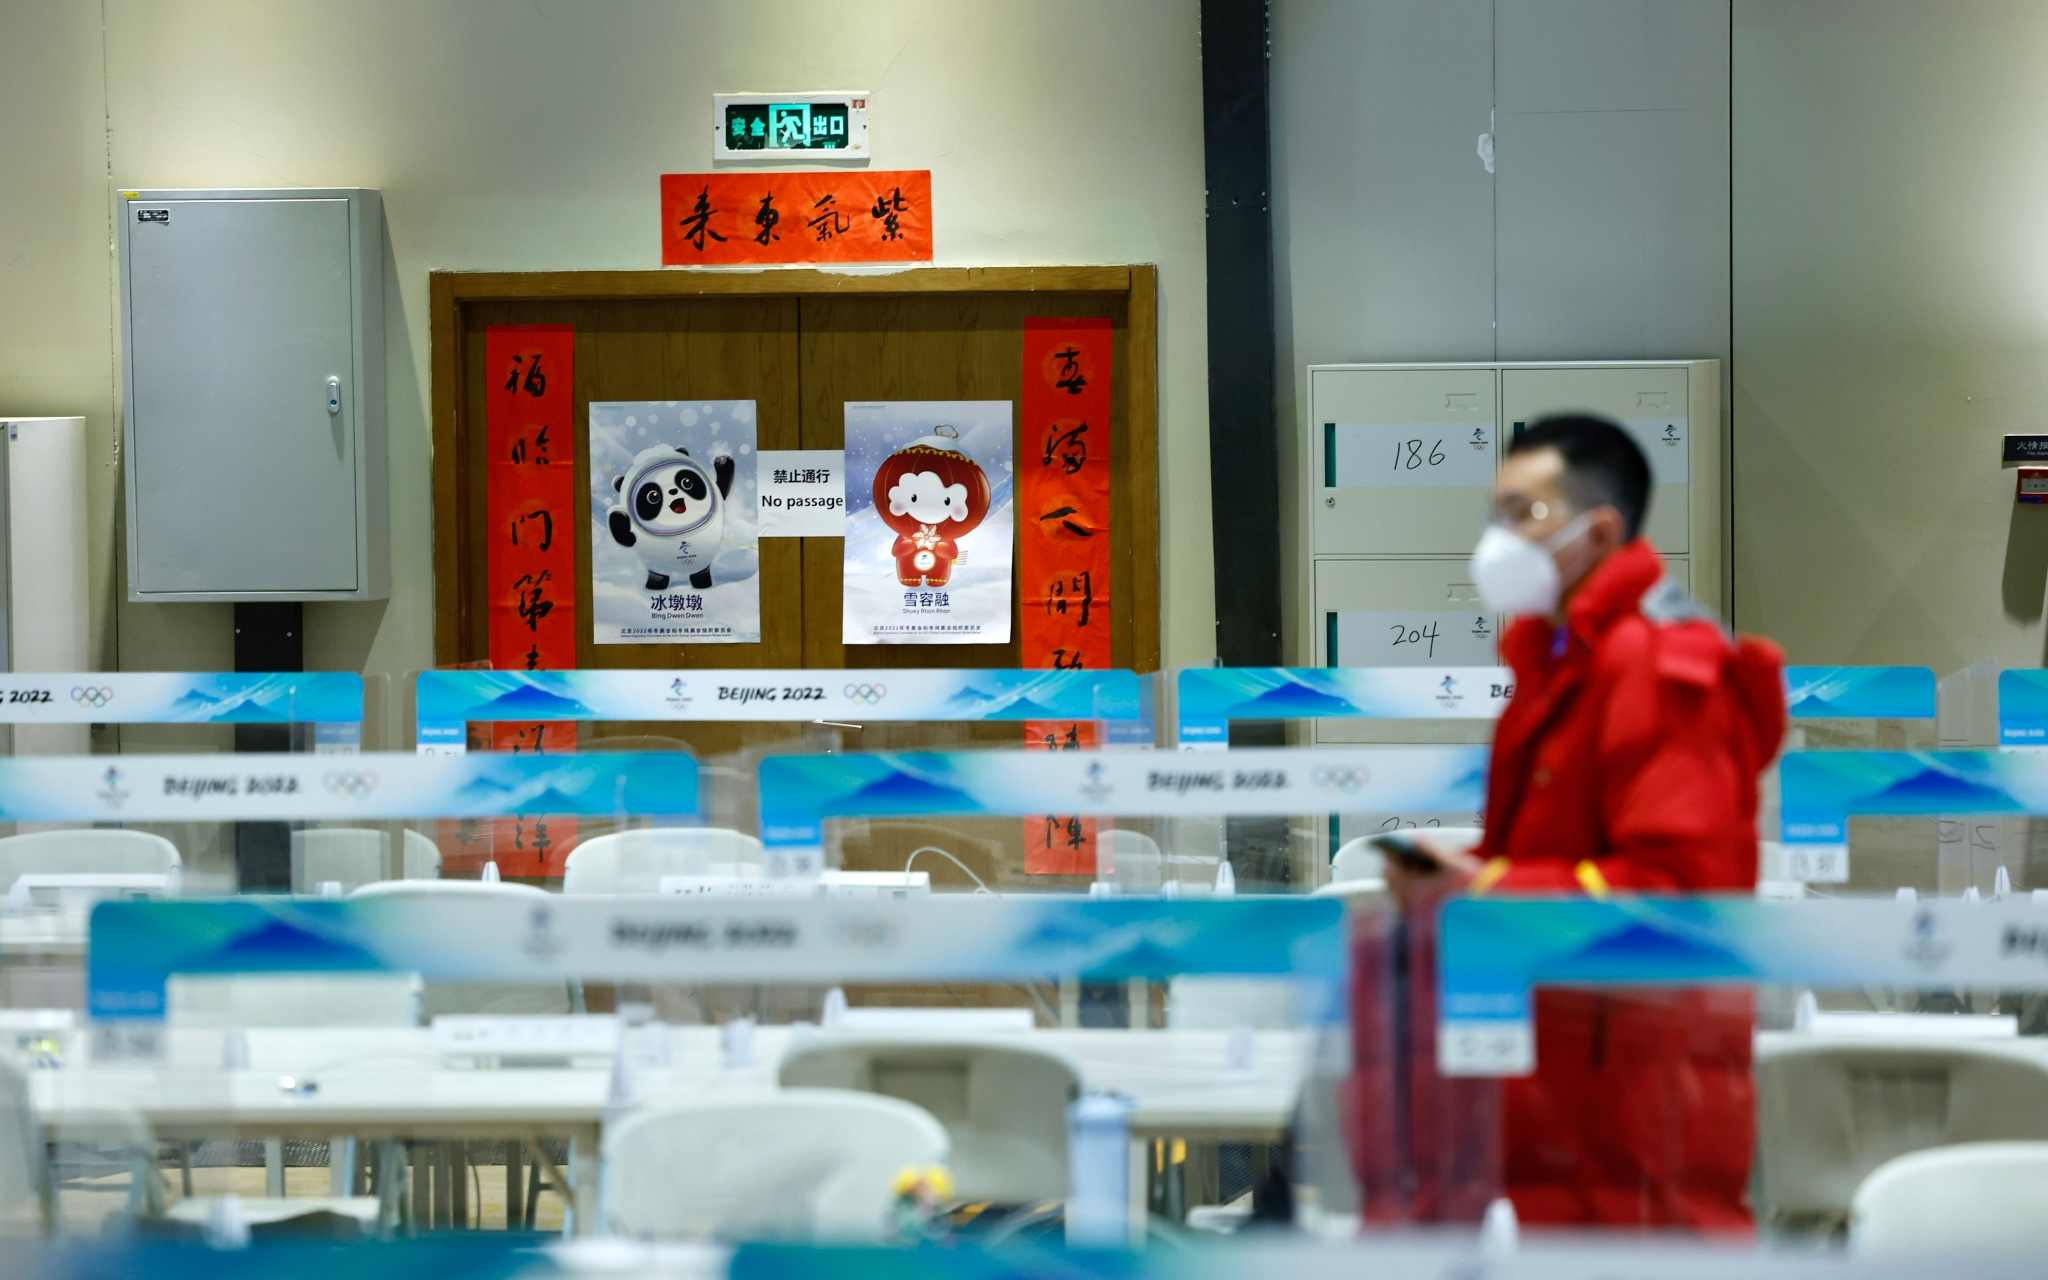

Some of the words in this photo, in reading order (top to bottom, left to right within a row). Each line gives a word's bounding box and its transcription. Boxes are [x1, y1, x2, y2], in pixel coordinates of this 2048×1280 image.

[731, 116, 766, 137] 安全
[812, 115, 844, 136] 出口
[1393, 438, 1446, 471] 186
[773, 469, 830, 484] 禁止通行
[762, 495, 782, 507] No
[787, 497, 843, 510] passage
[650, 594, 703, 611] 冰墩墩
[903, 592, 950, 607] 雪容融
[651, 612, 666, 620] Bing
[1390, 621, 1440, 658] 204
[9, 690, 54, 703] 2022
[718, 686, 776, 705] BEIJING
[782, 687, 826, 701] 2022
